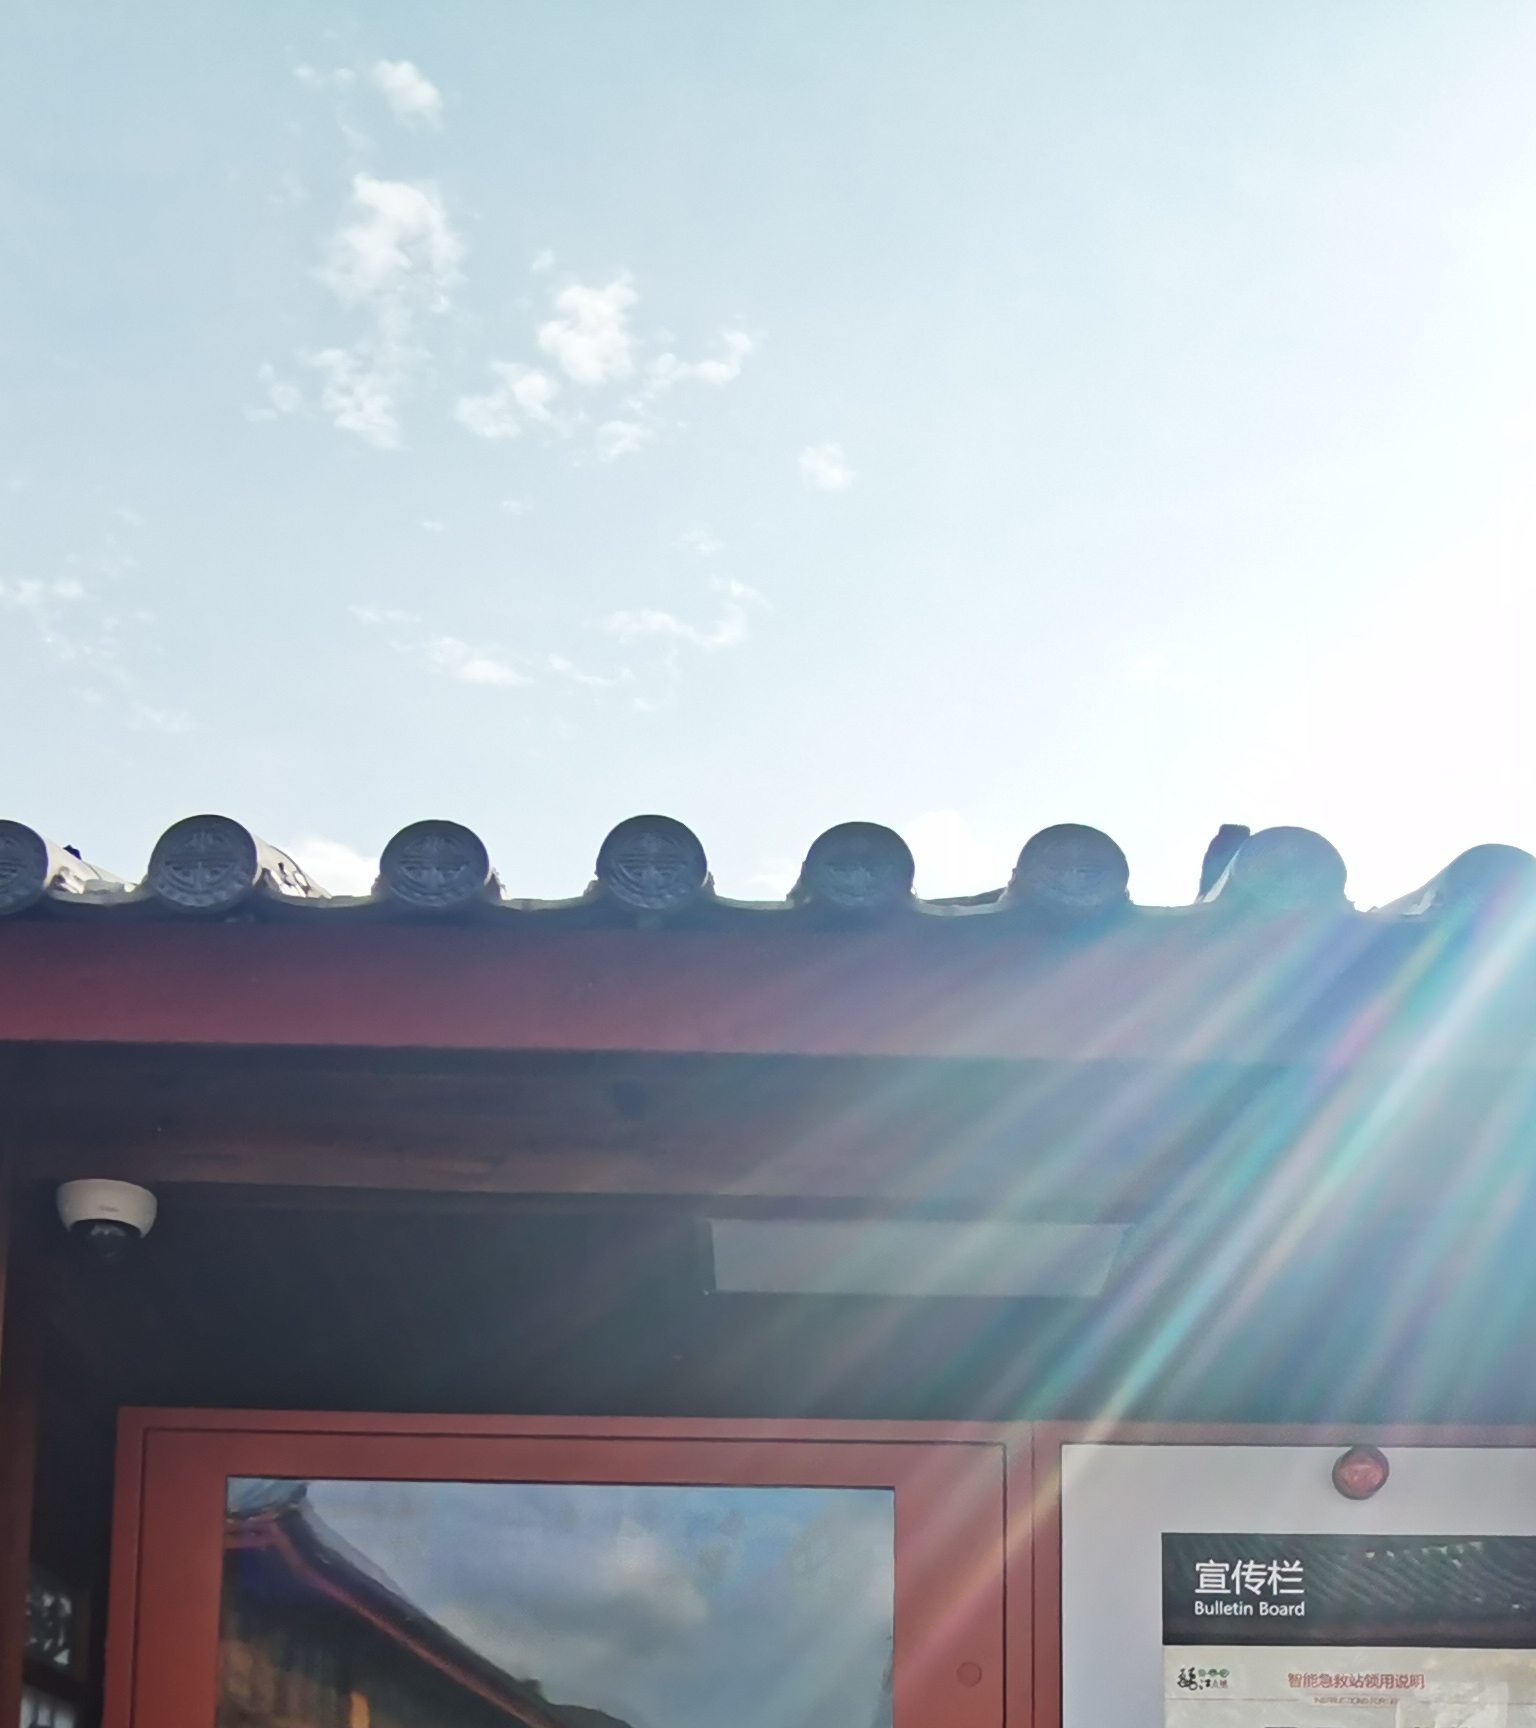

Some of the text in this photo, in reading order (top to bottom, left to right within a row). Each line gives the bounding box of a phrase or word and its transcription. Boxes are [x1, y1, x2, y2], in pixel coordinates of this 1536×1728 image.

[1194, 1558, 1305, 1596] 宣传栏
[1194, 1600, 1305, 1616] Bulletin Board
[1287, 1672, 1425, 1690] 智能急救站领用说明
